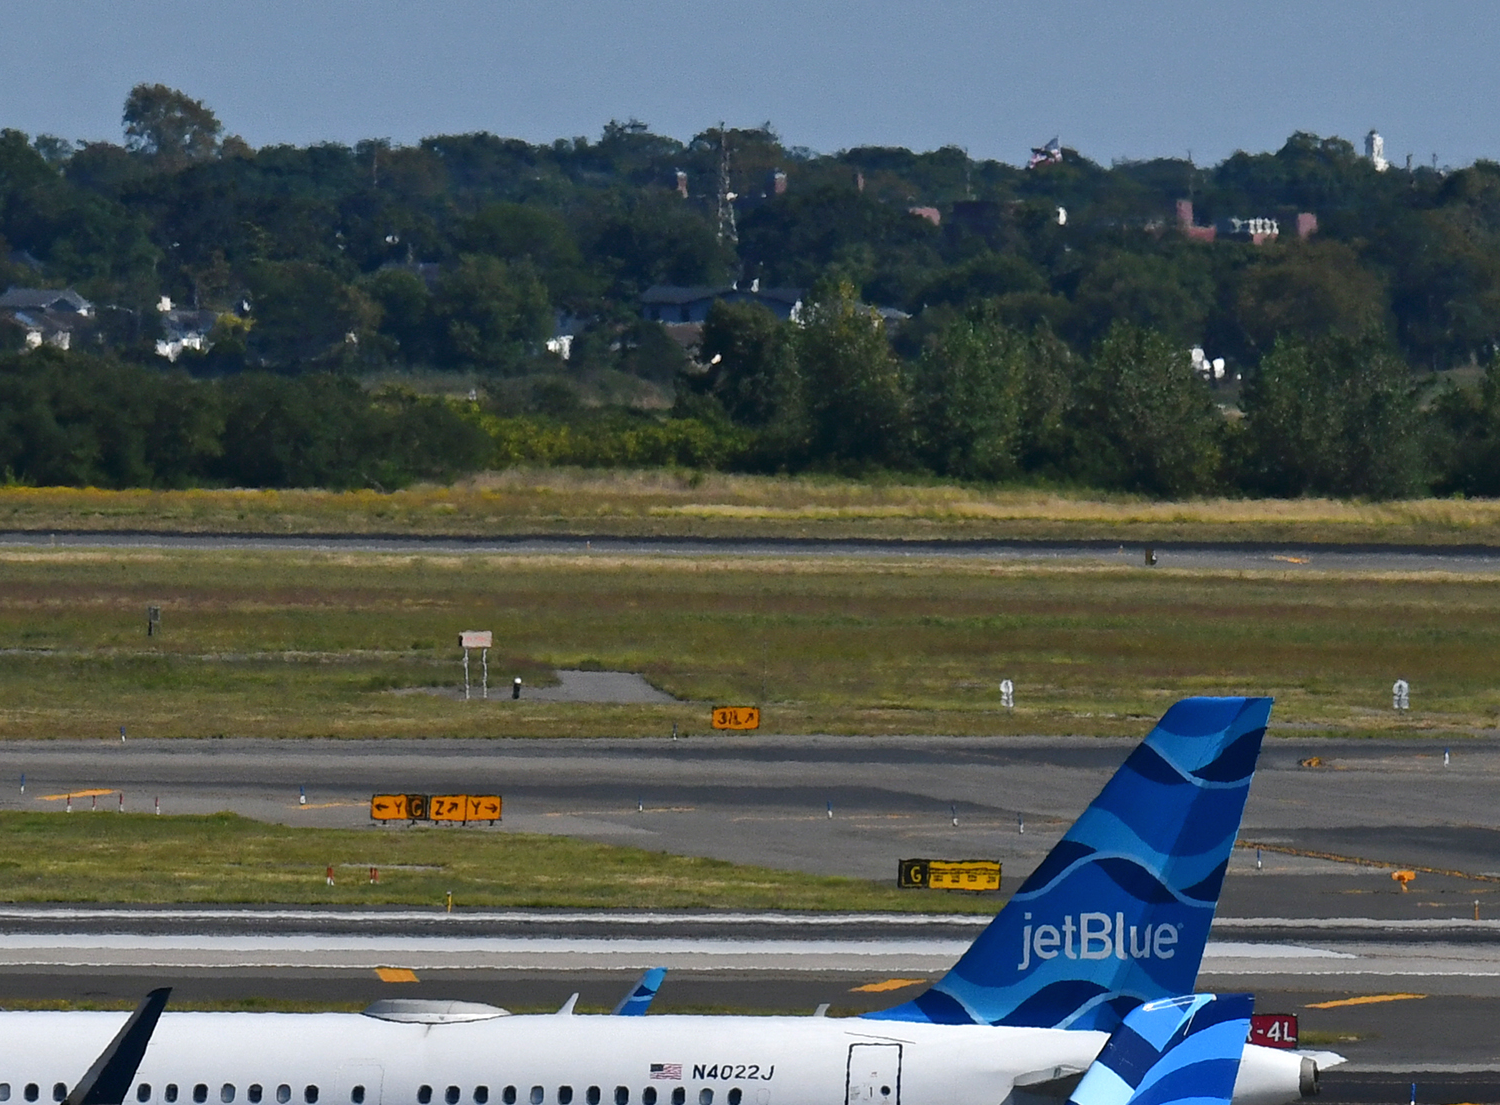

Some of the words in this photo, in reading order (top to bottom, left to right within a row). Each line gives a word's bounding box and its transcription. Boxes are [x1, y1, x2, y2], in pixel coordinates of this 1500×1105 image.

[394, 800, 403, 815] Y
[435, 800, 445, 816] Z
[471, 800, 481, 815] Y
[910, 866, 922, 883] G
[692, 1064, 775, 1081] N4022J
